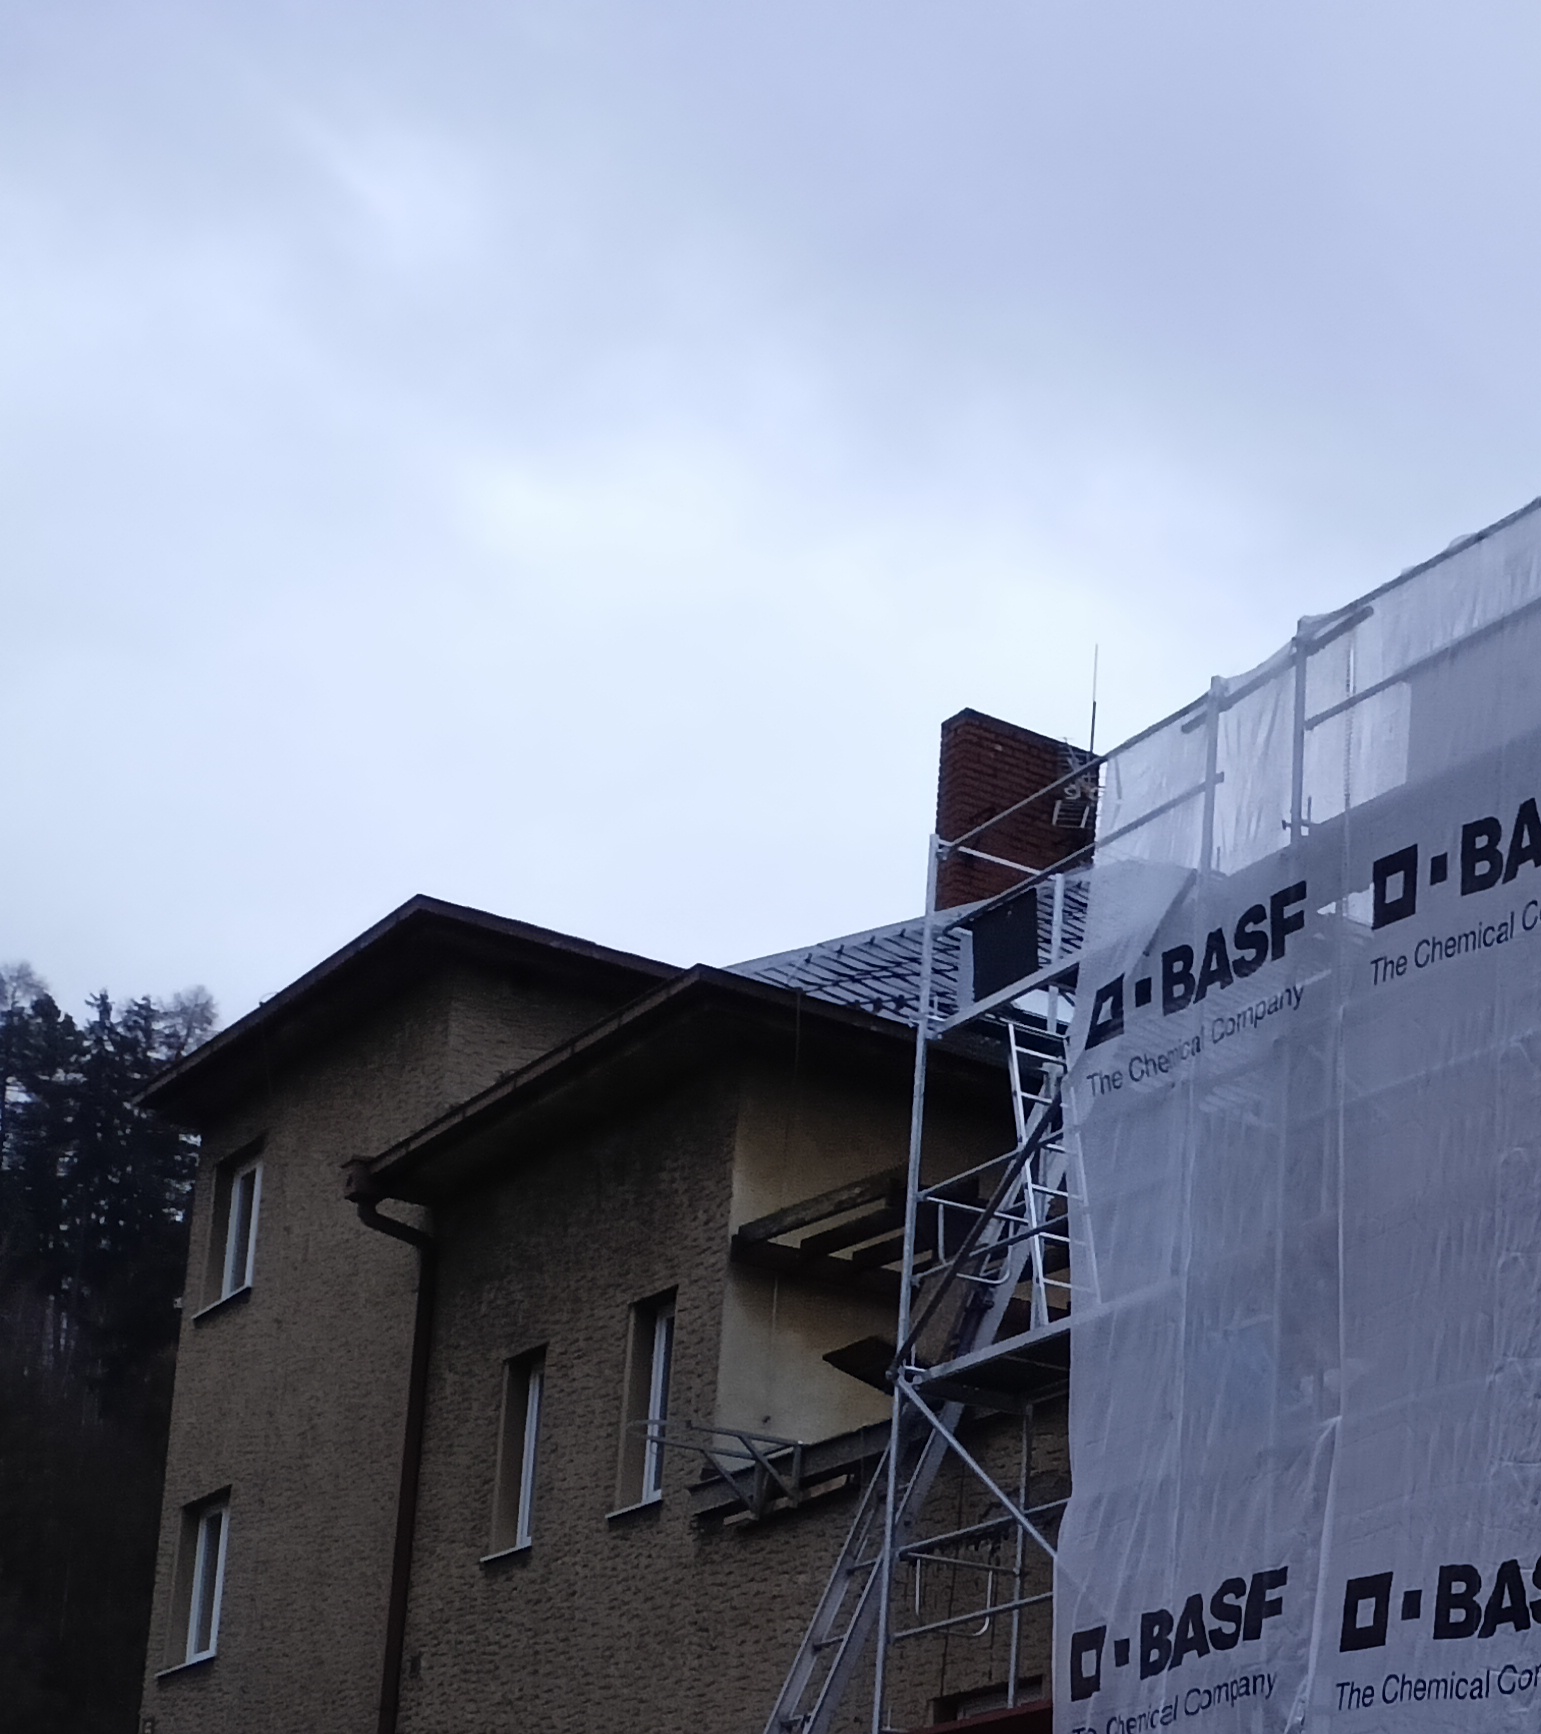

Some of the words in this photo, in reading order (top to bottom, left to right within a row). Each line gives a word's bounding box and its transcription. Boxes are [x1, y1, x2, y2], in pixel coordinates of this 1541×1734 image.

[1161, 880, 1307, 1016] BASF
[1371, 957, 1408, 986] The
[1414, 912, 1515, 969] Chemical
[1087, 1070, 1123, 1099] The
[1129, 1024, 1204, 1084] Chemical
[1211, 981, 1305, 1044] Company
[1139, 1566, 1288, 1680] BASF
[1184, 1673, 1277, 1717] Company
[1335, 1681, 1375, 1711] The
[1381, 1669, 1490, 1705] Chemical
